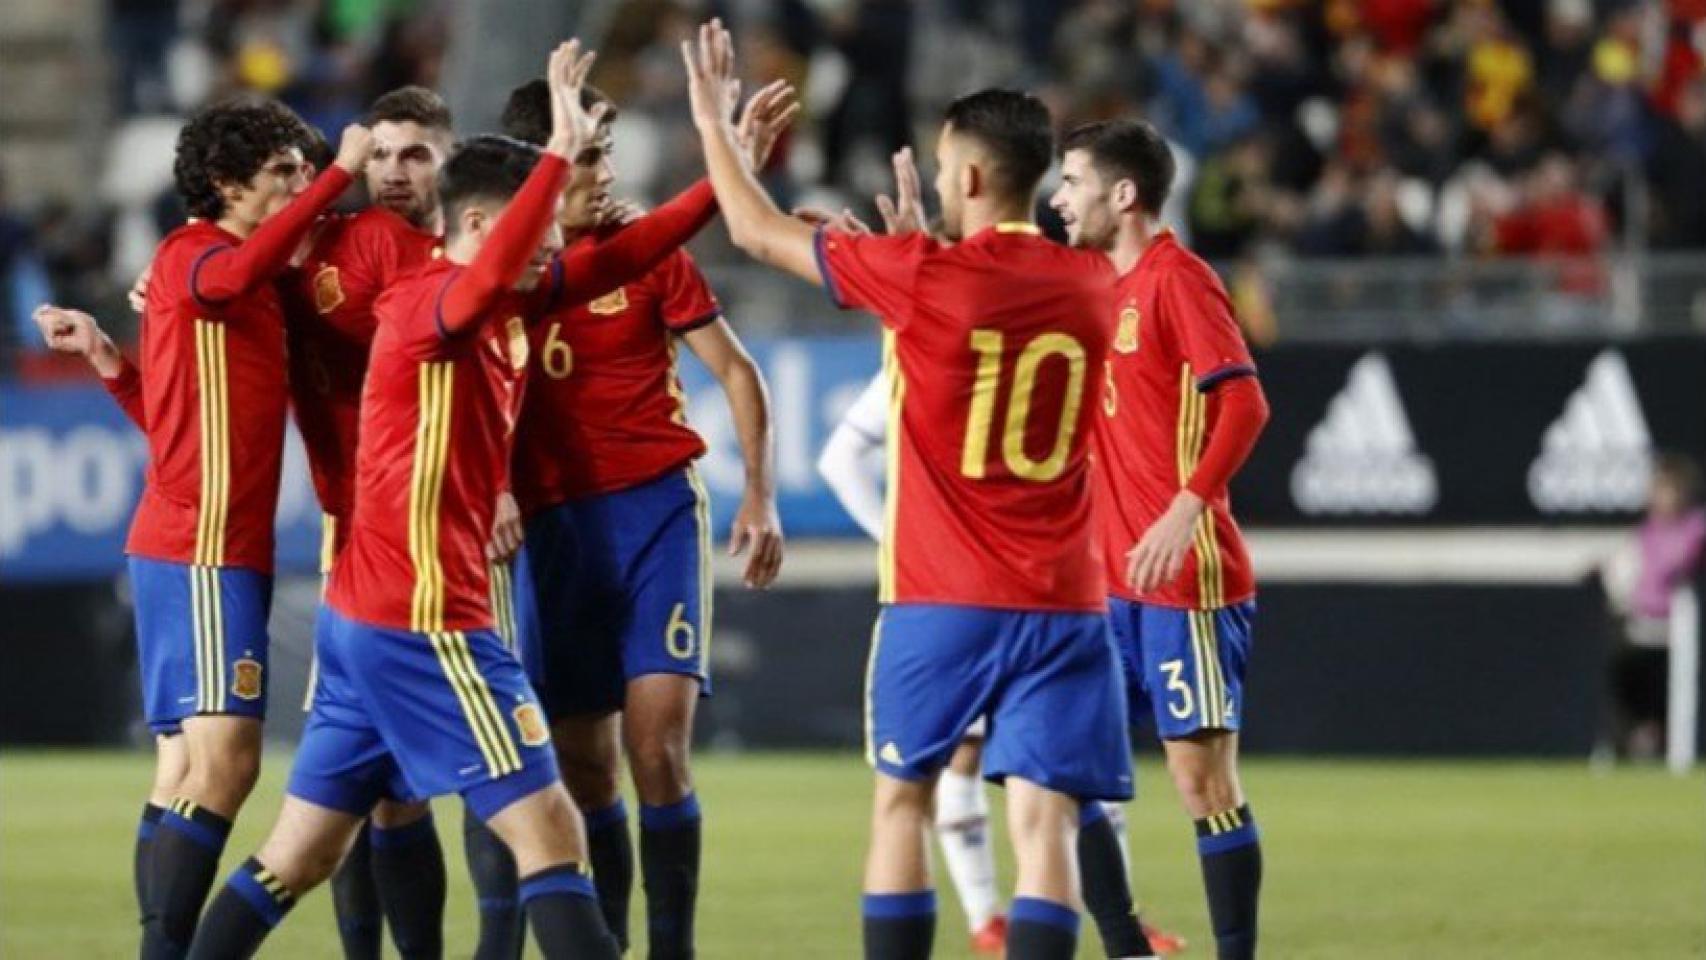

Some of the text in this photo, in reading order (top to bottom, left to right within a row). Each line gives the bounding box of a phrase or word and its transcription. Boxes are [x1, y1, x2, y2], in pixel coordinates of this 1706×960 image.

[543, 322, 573, 379] 6
[961, 330, 1086, 481] 10
[0, 424, 147, 560] po
[665, 602, 695, 659] 6
[1159, 659, 1193, 719] 3
